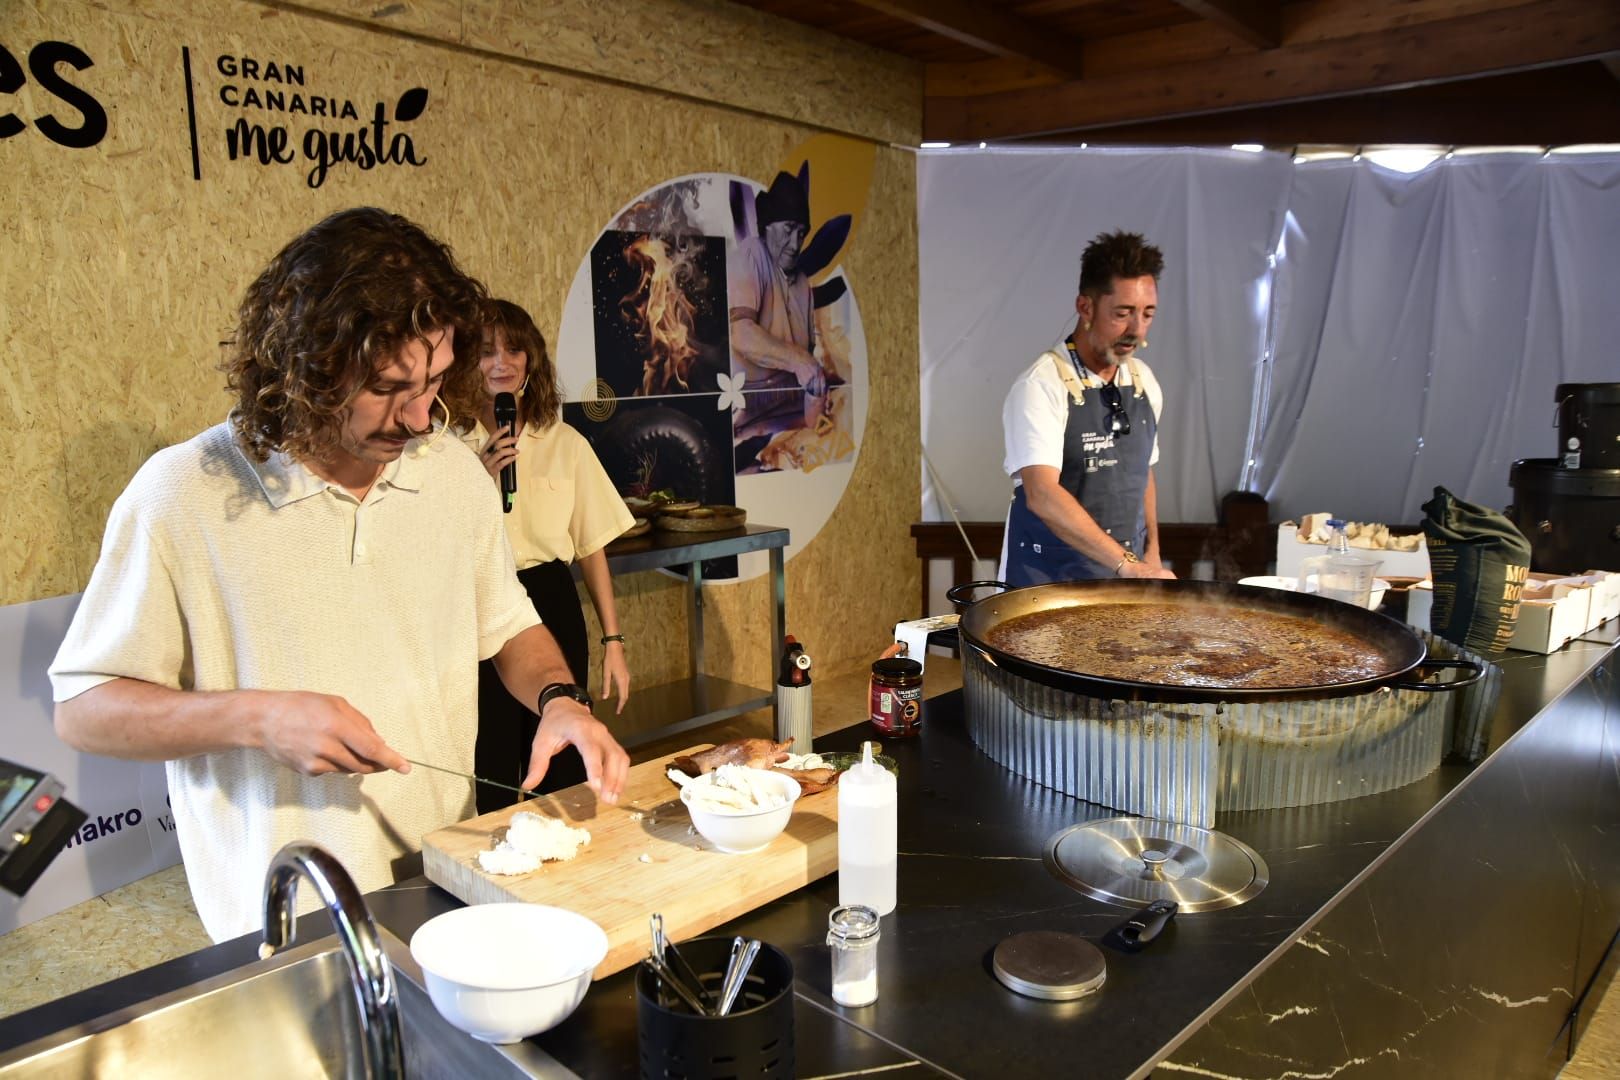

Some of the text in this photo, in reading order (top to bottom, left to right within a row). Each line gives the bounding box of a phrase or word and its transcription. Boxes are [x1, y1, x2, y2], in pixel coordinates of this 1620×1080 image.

[217, 54, 305, 86] GRAN
[219, 85, 359, 121] CANARIA
[226, 102, 428, 189] me gusta
